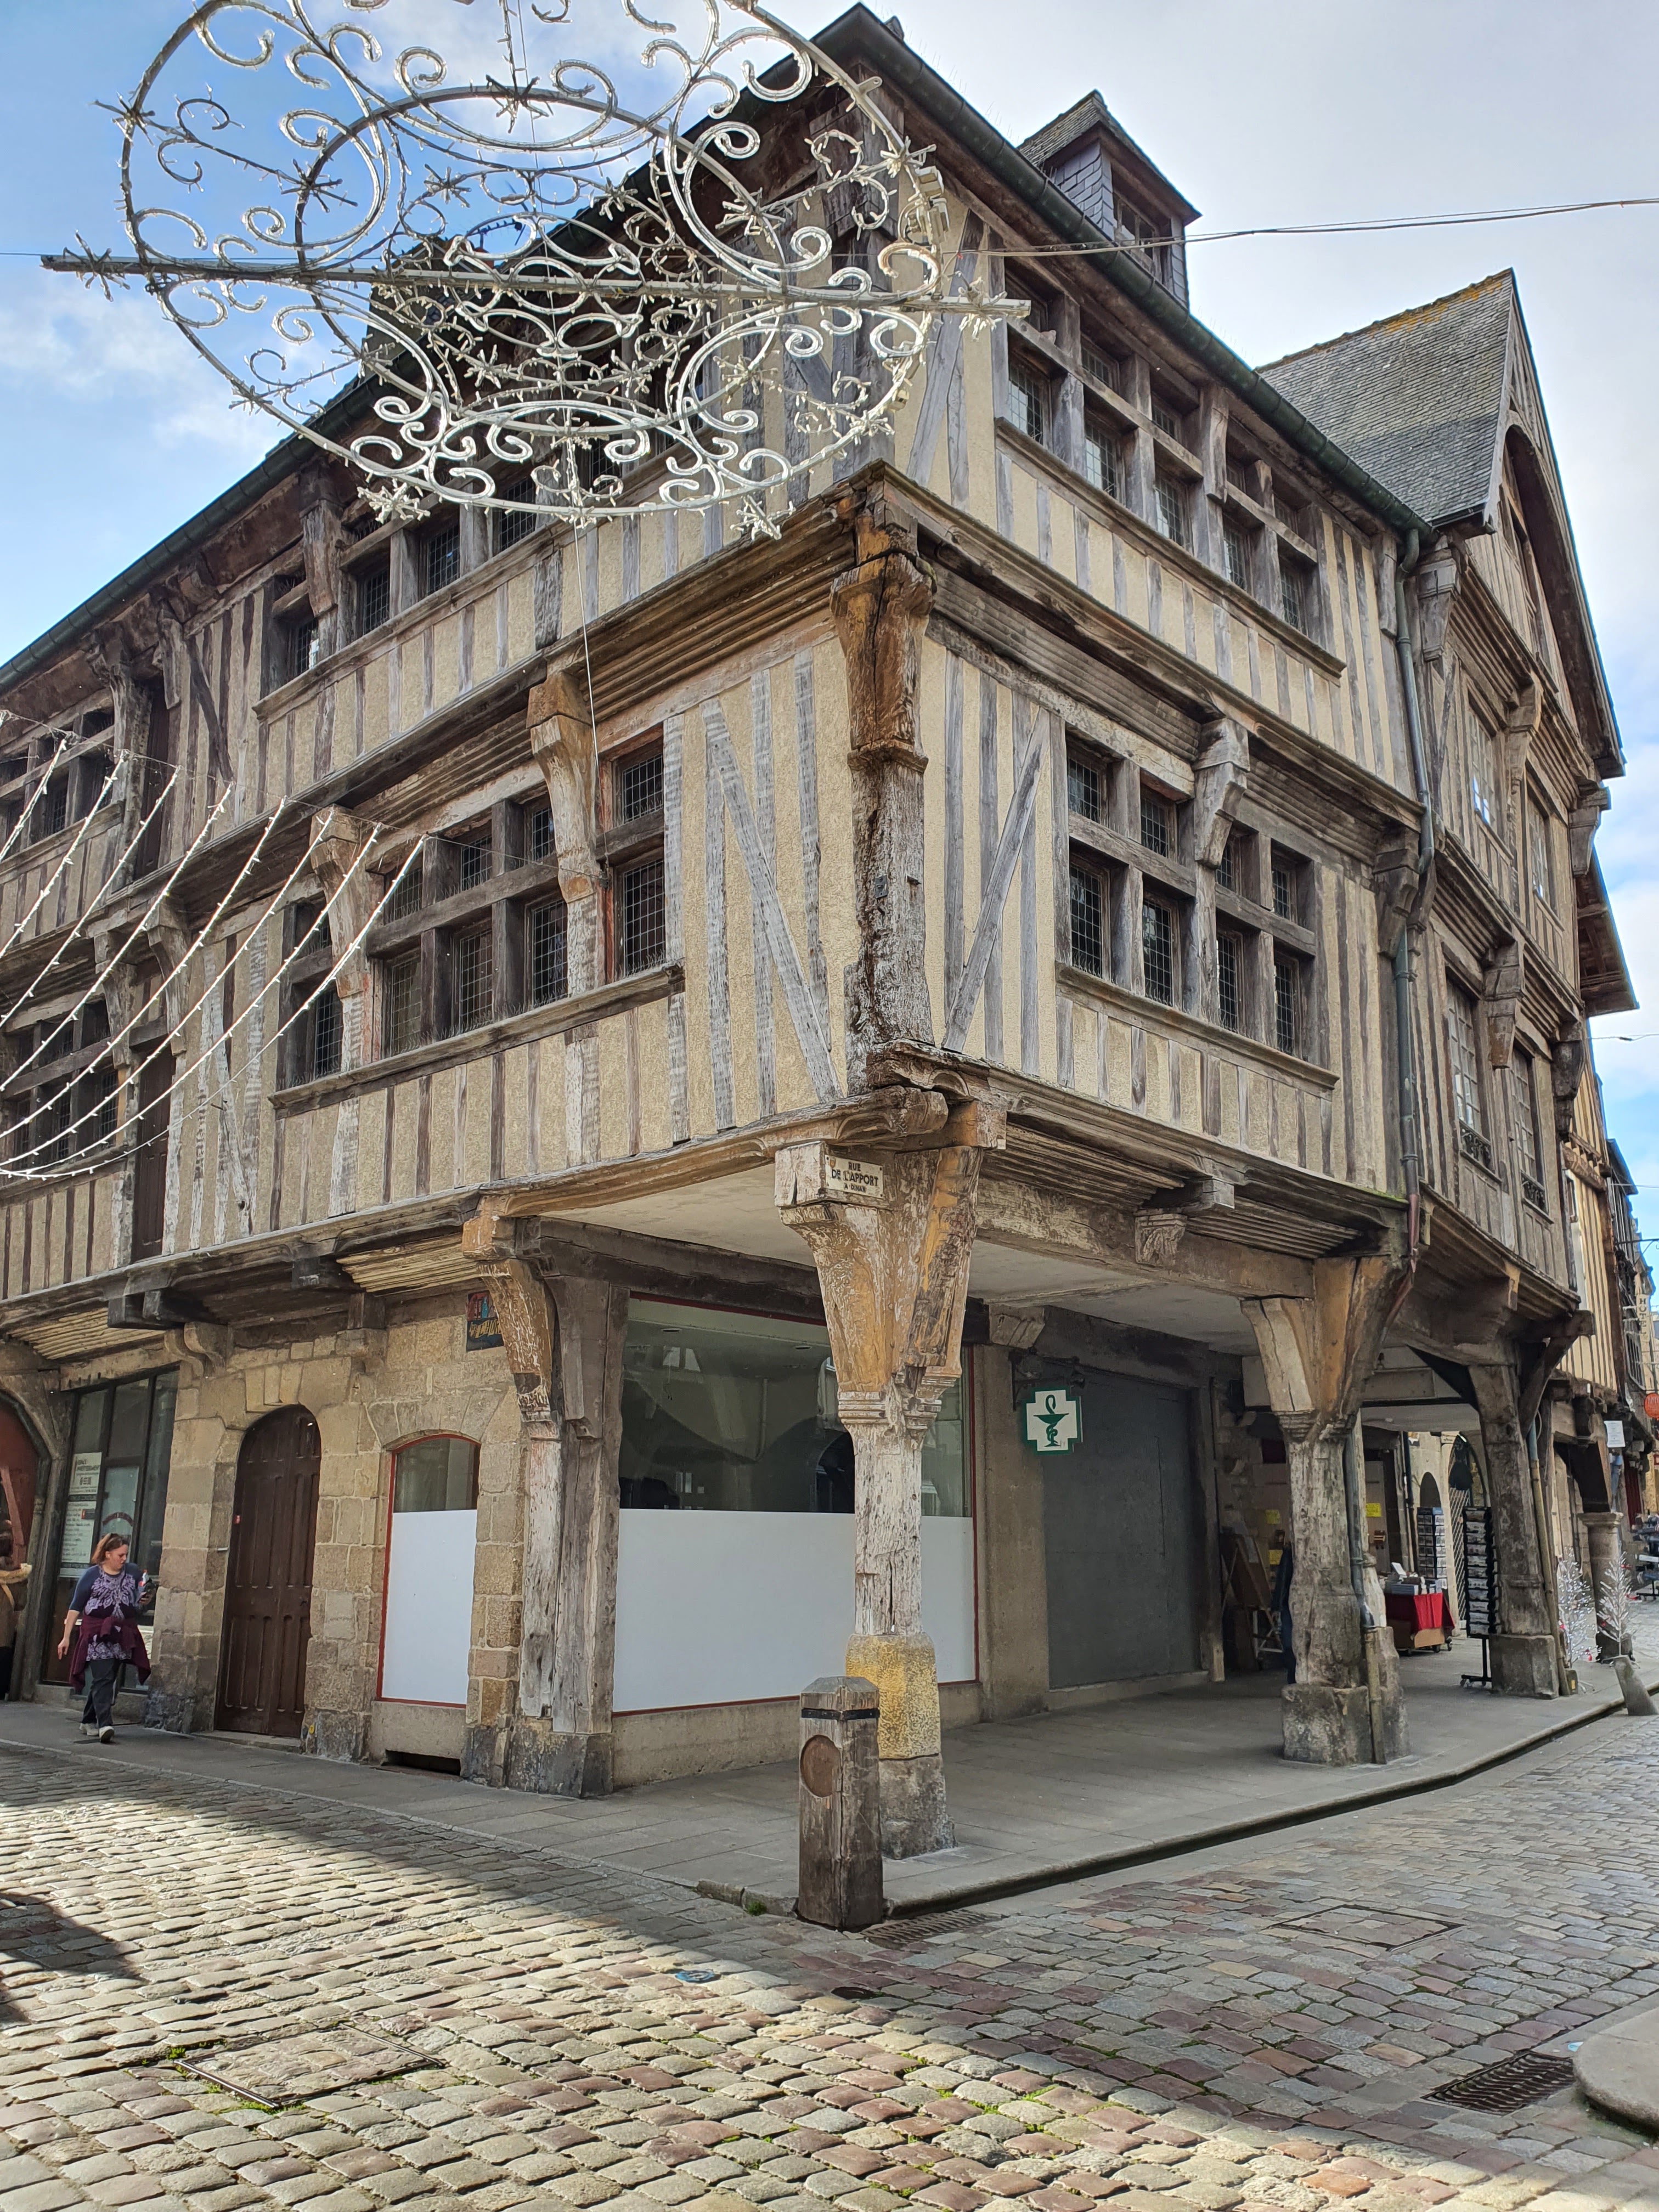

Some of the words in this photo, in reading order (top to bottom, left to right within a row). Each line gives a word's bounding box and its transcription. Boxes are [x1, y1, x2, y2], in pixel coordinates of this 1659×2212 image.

[848, 1161, 861, 1172] RUE
[832, 1169, 841, 1180] DE
[843, 1170, 878, 1187] L'APPORT
[851, 1183, 866, 1193] DINAN
